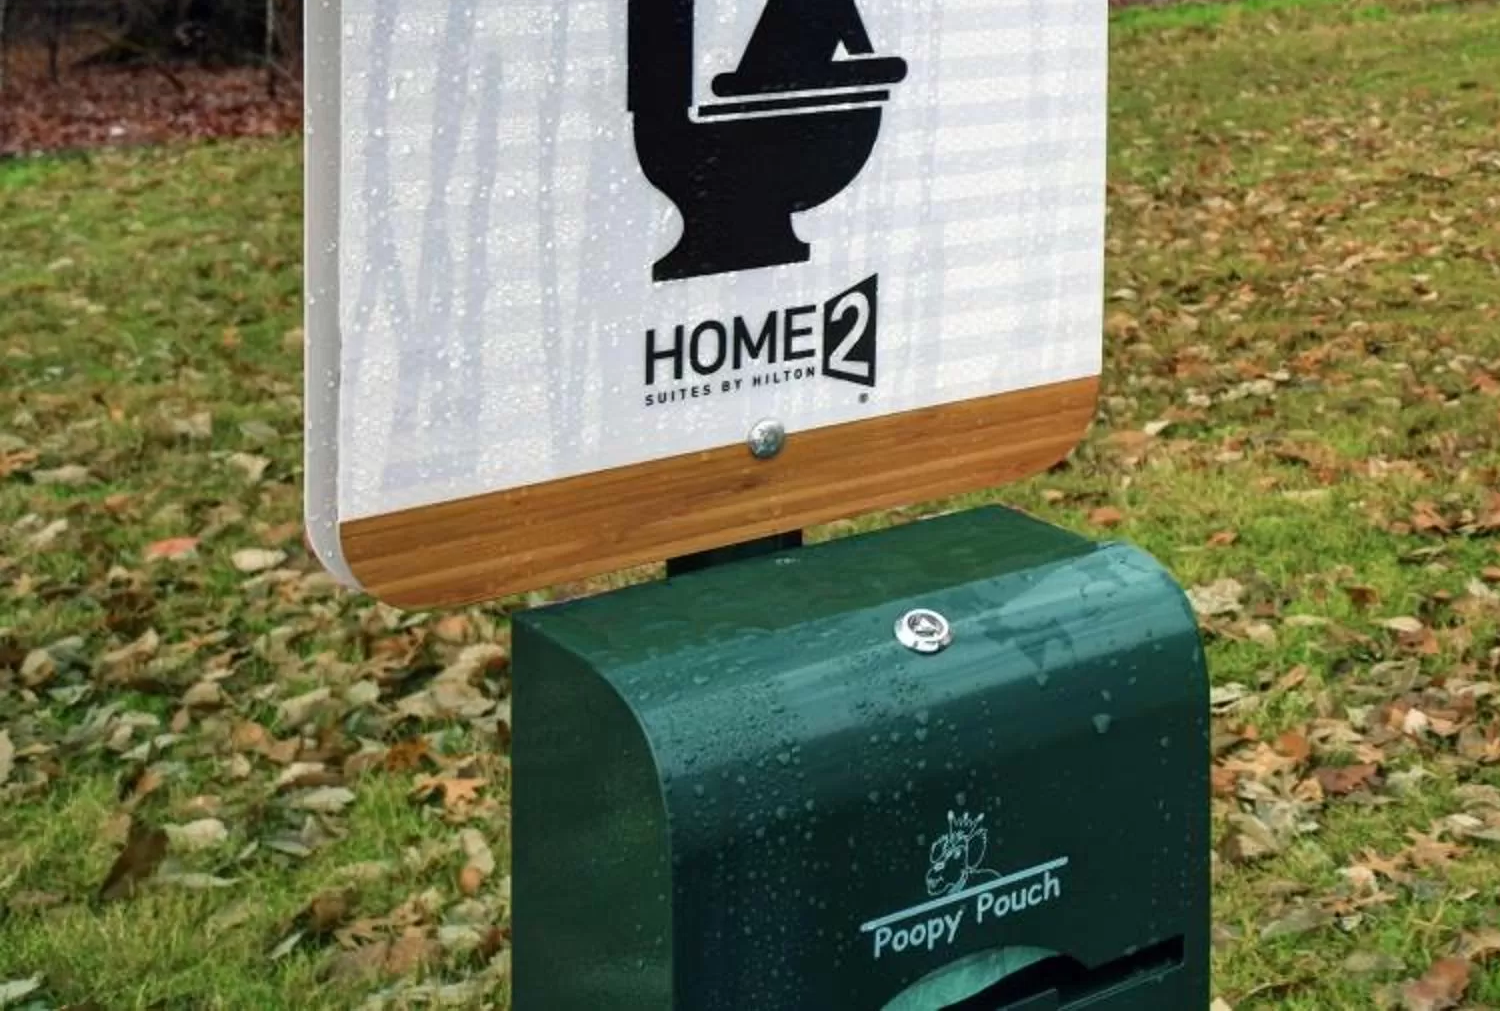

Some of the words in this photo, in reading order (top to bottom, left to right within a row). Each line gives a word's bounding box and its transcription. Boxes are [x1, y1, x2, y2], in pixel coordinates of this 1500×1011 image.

[644, 383, 712, 407] SUITES
[721, 378, 743, 393] BY
[752, 366, 816, 388] HILTON
[873, 909, 964, 959] Poopy
[976, 871, 1062, 925] Pouch
